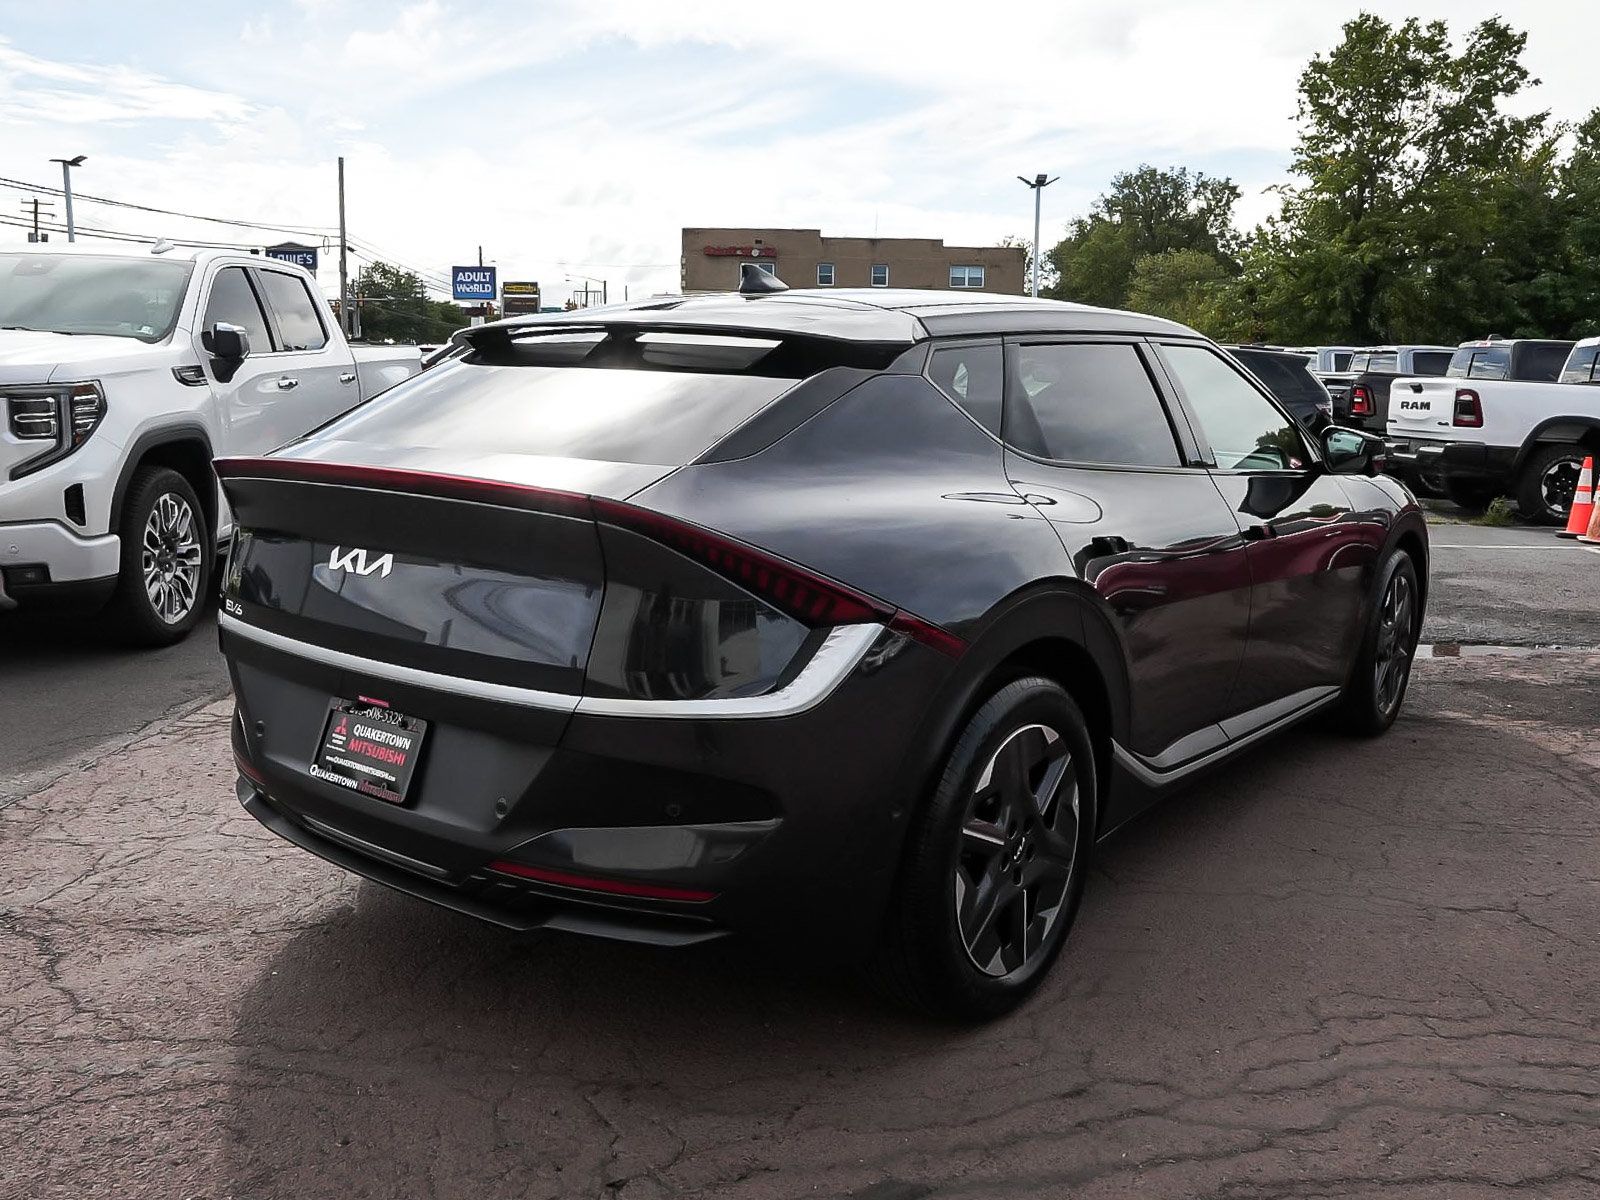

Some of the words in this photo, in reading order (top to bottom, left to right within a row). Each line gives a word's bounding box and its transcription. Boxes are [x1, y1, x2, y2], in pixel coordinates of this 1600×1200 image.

[269, 253, 313, 264] OWE'S
[456, 271, 491, 282] ADULT
[456, 283, 492, 293] WORLD
[1400, 401, 1431, 411] RAM
[328, 545, 393, 579] KIA
[225, 599, 243, 616] EV6
[353, 724, 412, 750] QUAKERTOWN
[348, 739, 407, 767] MITSUBISHI
[309, 764, 358, 789] QUAKERTOWN
